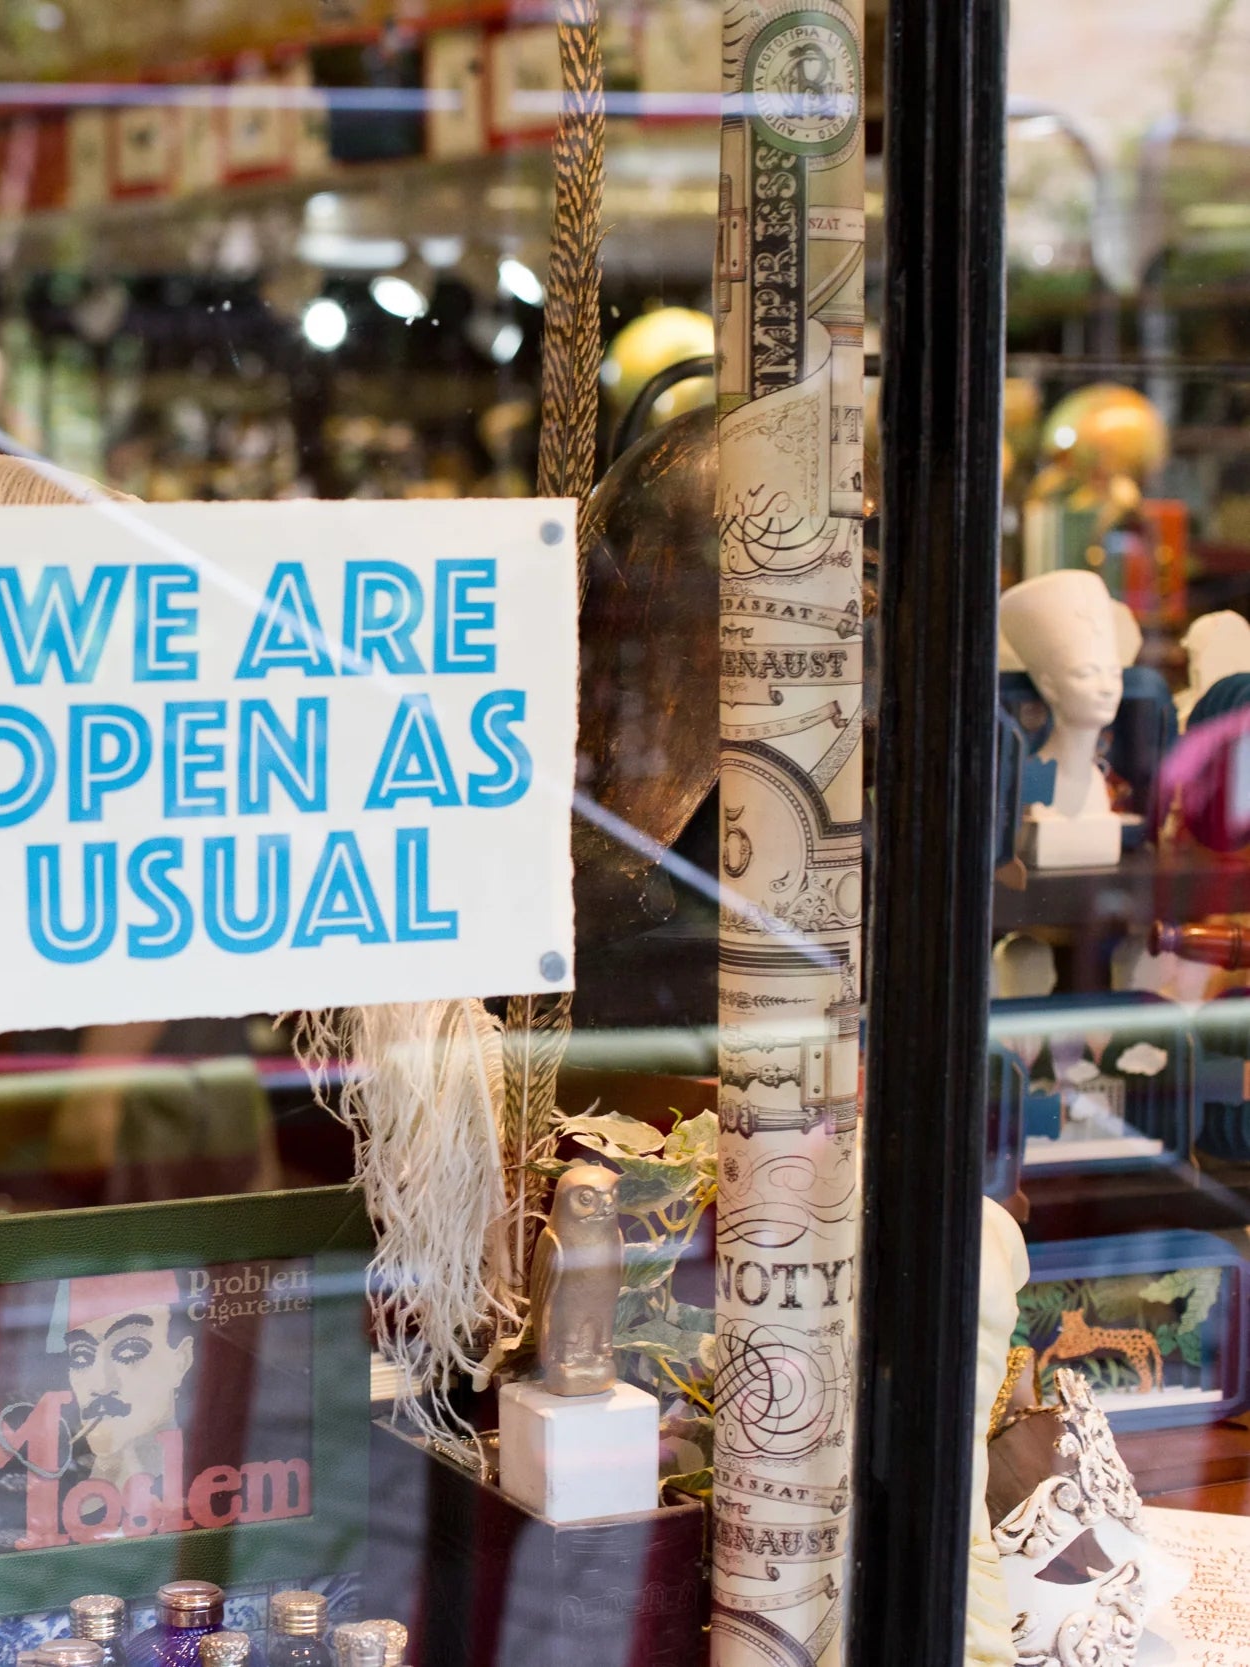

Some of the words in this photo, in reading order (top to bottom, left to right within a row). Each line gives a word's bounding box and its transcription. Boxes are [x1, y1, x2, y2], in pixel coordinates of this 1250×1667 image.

[753, 137, 798, 398] IMPRESS
[234, 558, 497, 680] ARE
[720, 649, 848, 679] ENAUST
[363, 690, 534, 811] AS
[27, 827, 459, 965] USUAL
[717, 1254, 854, 1310] NOTY
[715, 1522, 839, 1556] ENAUST
